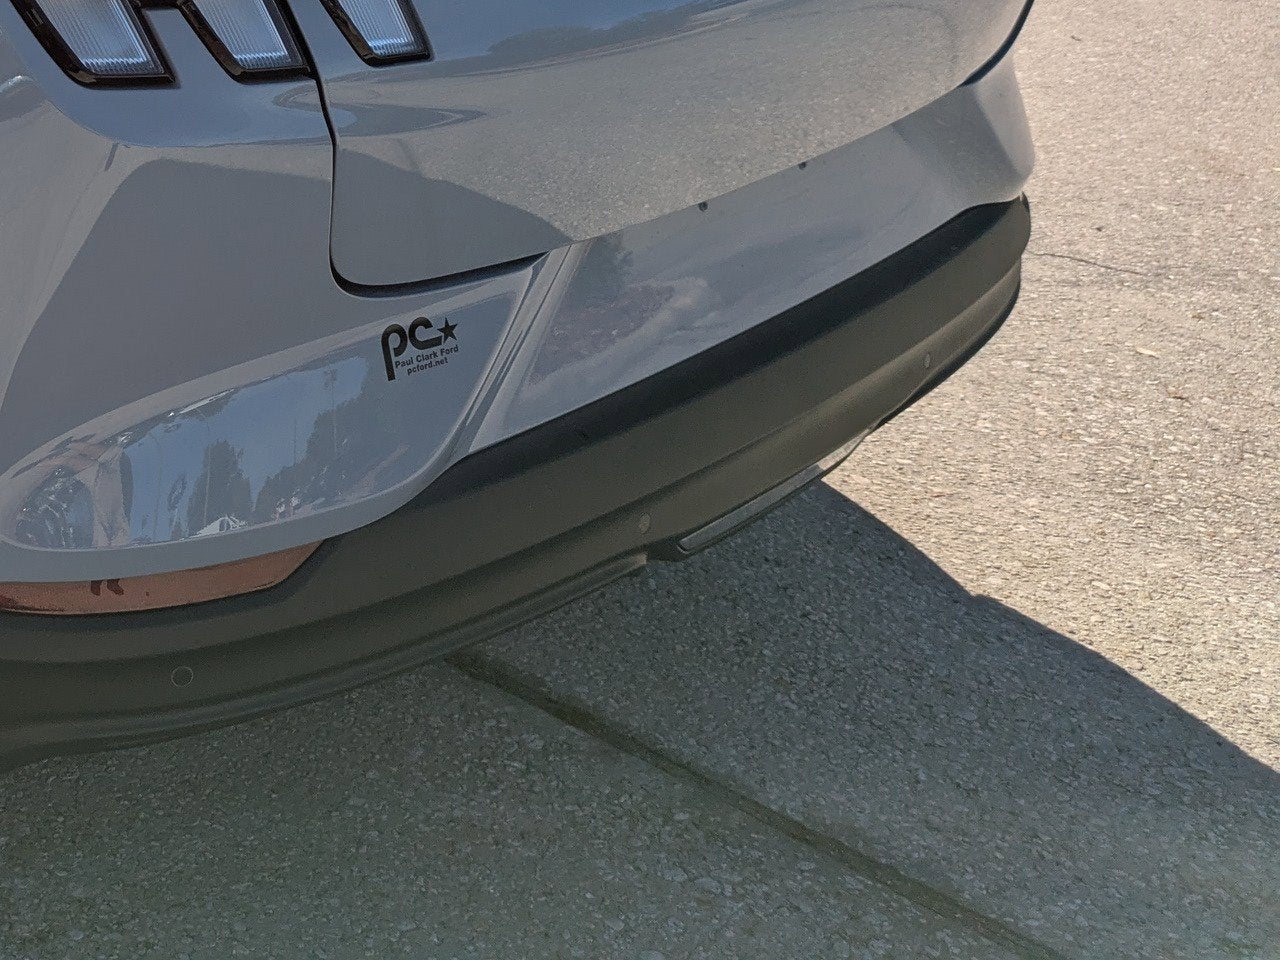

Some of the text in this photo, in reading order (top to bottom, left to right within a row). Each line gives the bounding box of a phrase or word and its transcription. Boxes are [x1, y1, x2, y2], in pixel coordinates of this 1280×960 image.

[394, 344, 459, 370] Paul Clark Ford
[406, 356, 449, 376] pcford.net
